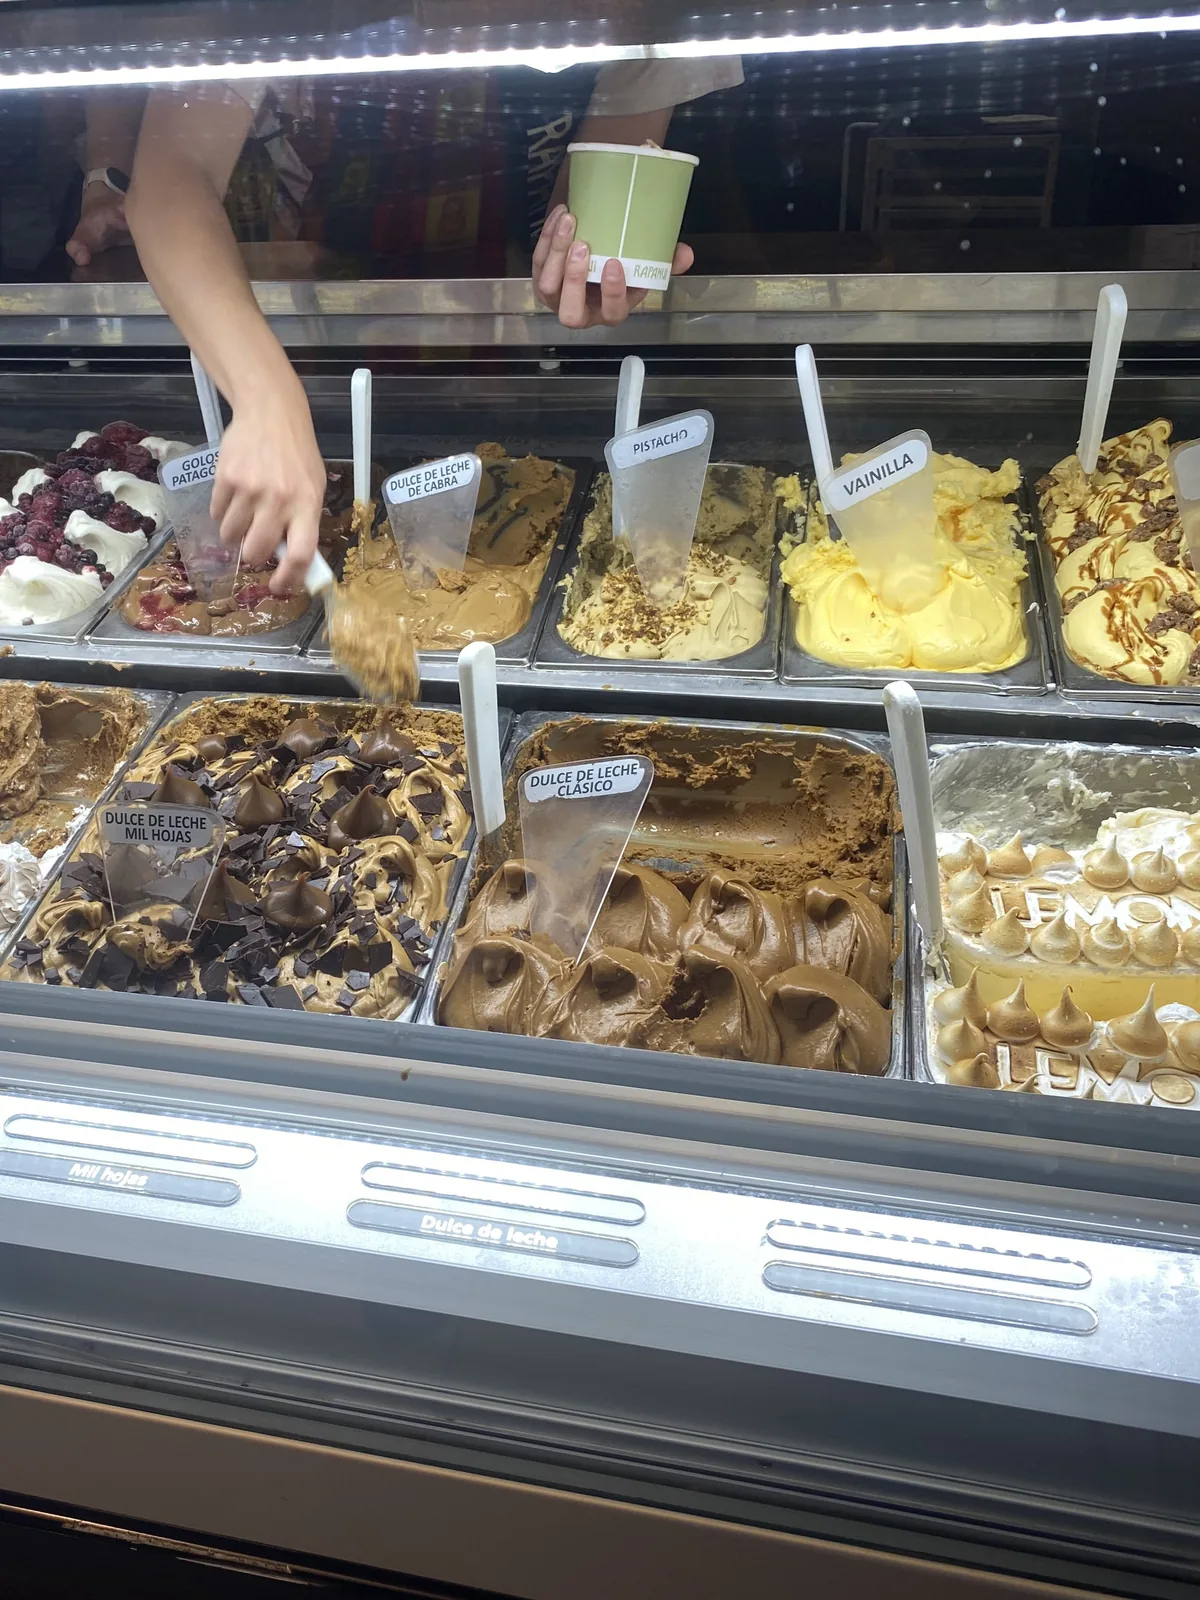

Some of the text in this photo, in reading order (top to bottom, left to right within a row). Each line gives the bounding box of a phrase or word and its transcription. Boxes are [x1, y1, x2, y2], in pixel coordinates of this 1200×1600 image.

[633, 429, 688, 454] PISTACHO
[390, 460, 471, 491] DULCE DE LECHE
[408, 475, 458, 497] DE CABRA
[843, 453, 914, 496] VAINILLA
[531, 763, 638, 788] DULCE DE LECHE
[105, 812, 207, 829] DULCE DE LECHE
[125, 828, 192, 843] MIL HOJAS
[99, 1167, 149, 1186] hojas
[420, 1214, 559, 1249] Dulce de leche
